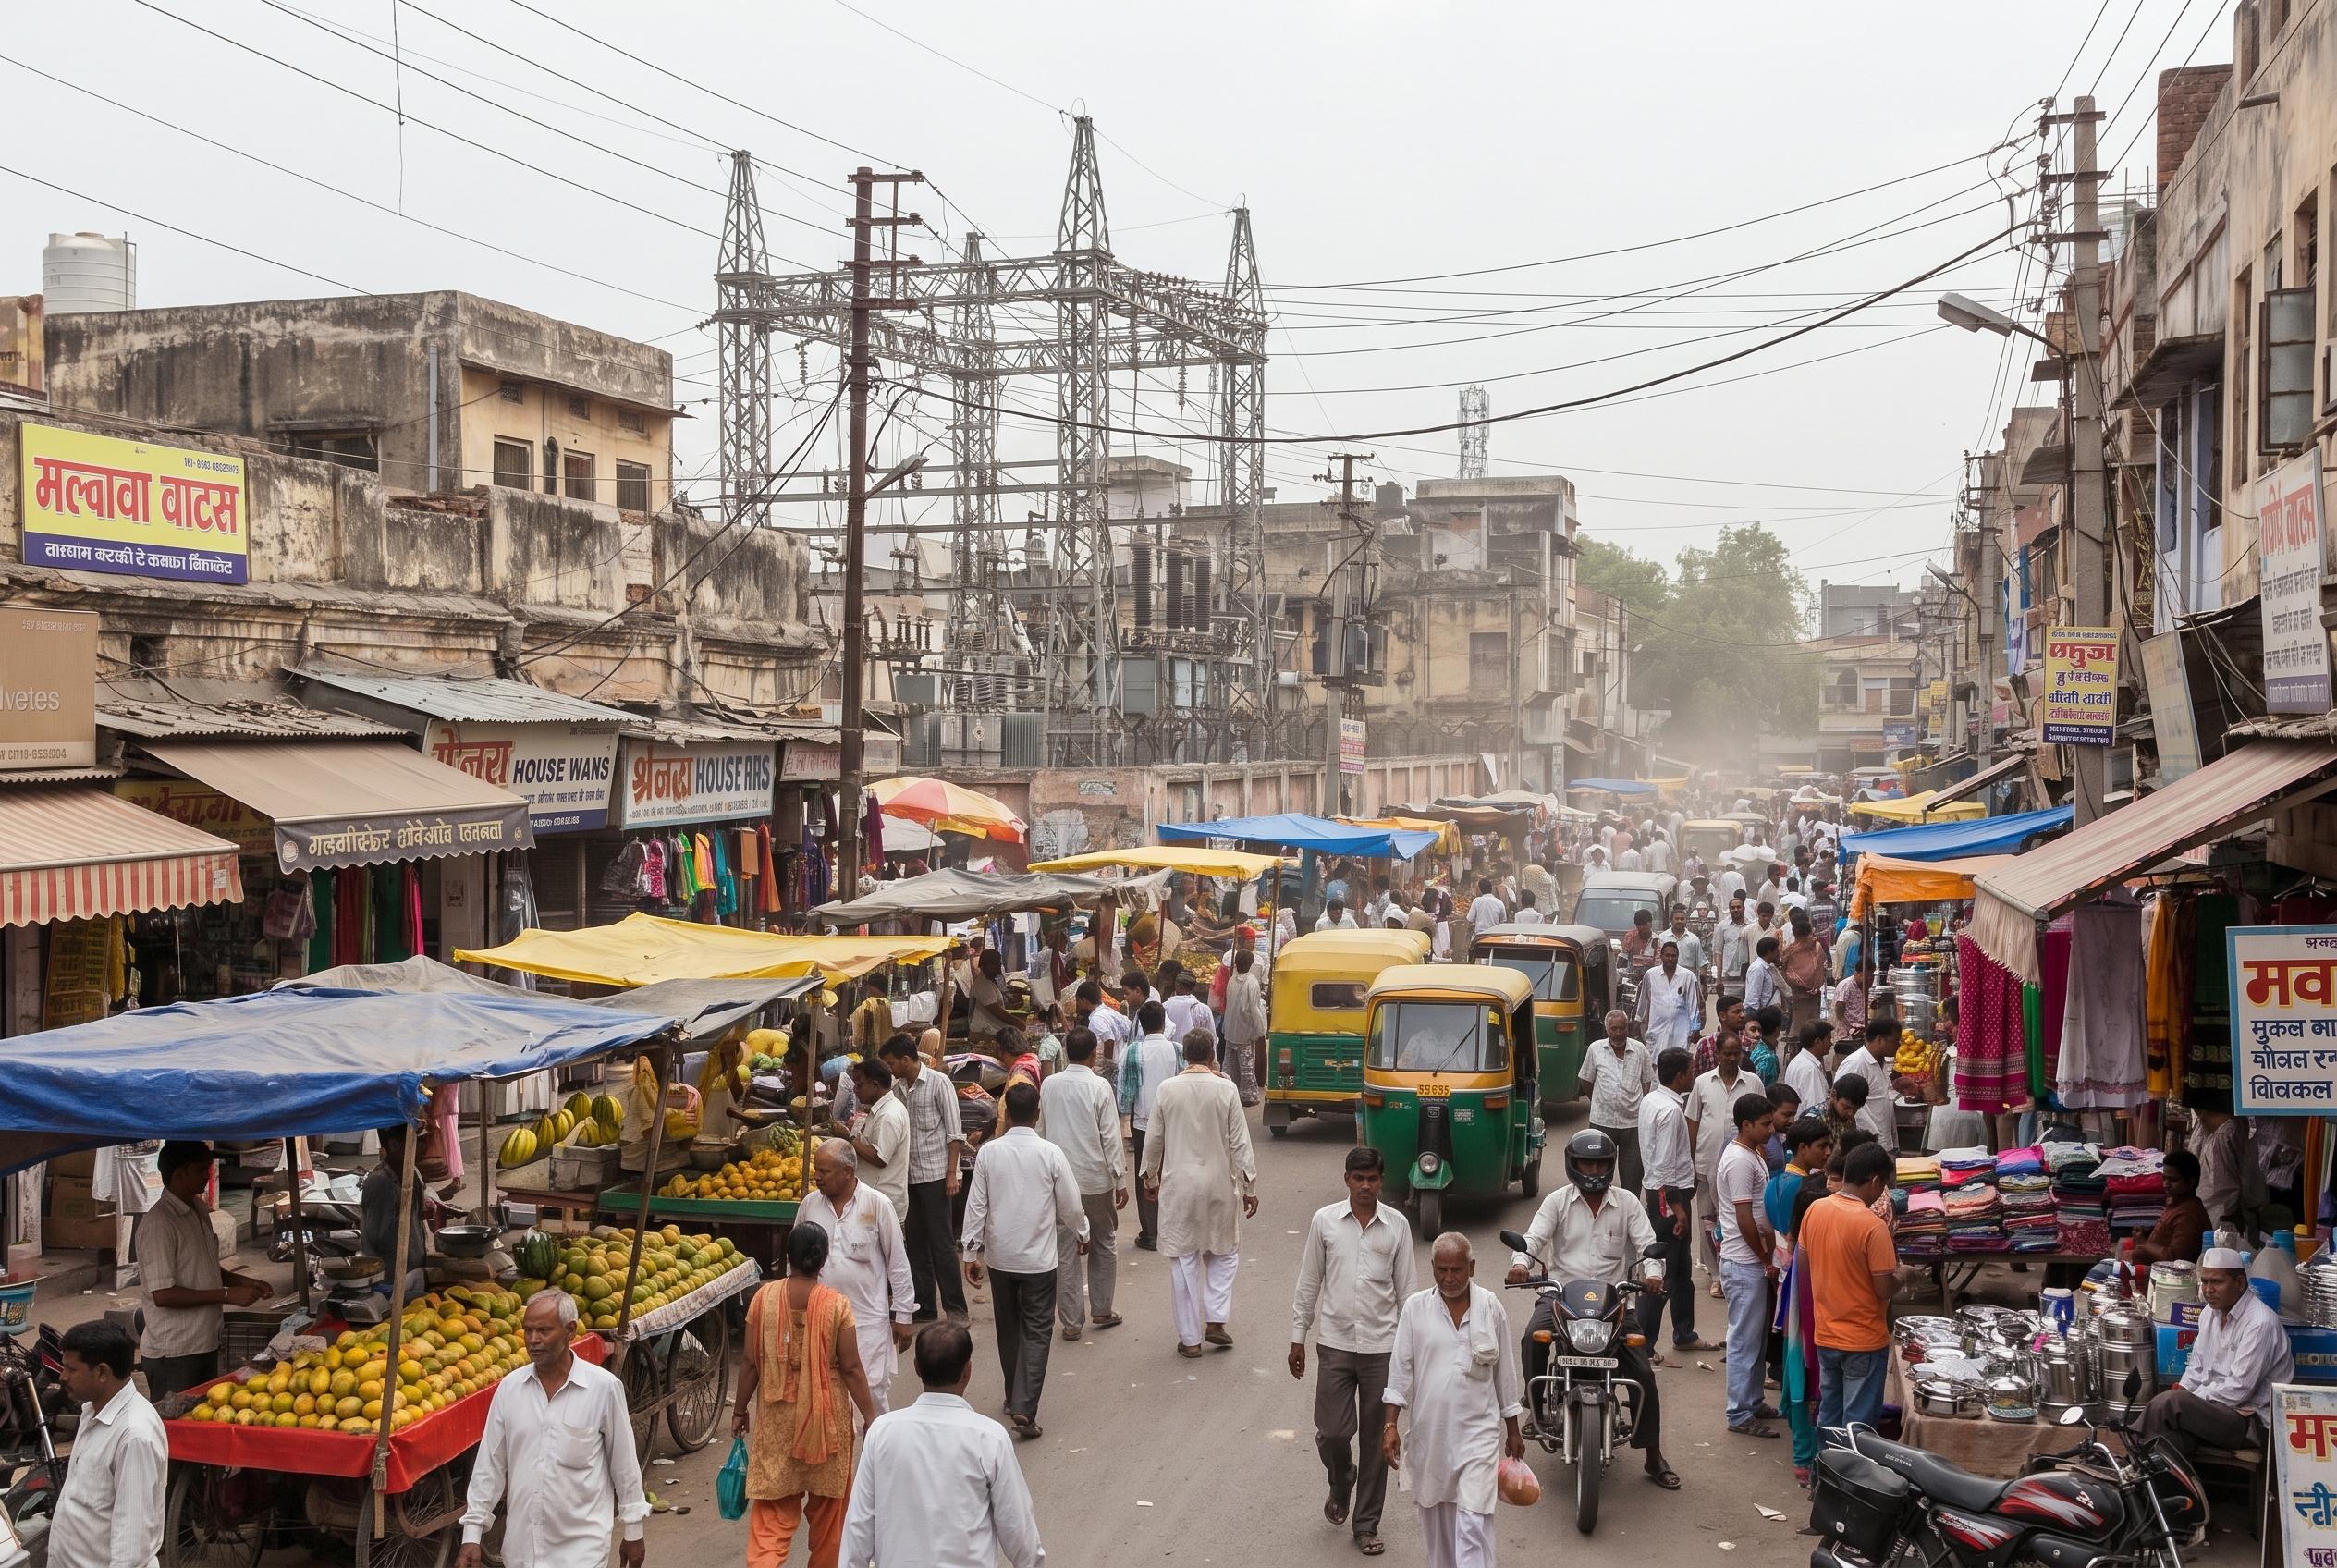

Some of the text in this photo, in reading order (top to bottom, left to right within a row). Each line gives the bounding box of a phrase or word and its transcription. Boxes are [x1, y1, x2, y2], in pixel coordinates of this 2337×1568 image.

[513, 756, 610, 783] HOUSE WANS
[695, 756, 743, 794] HOUSE
